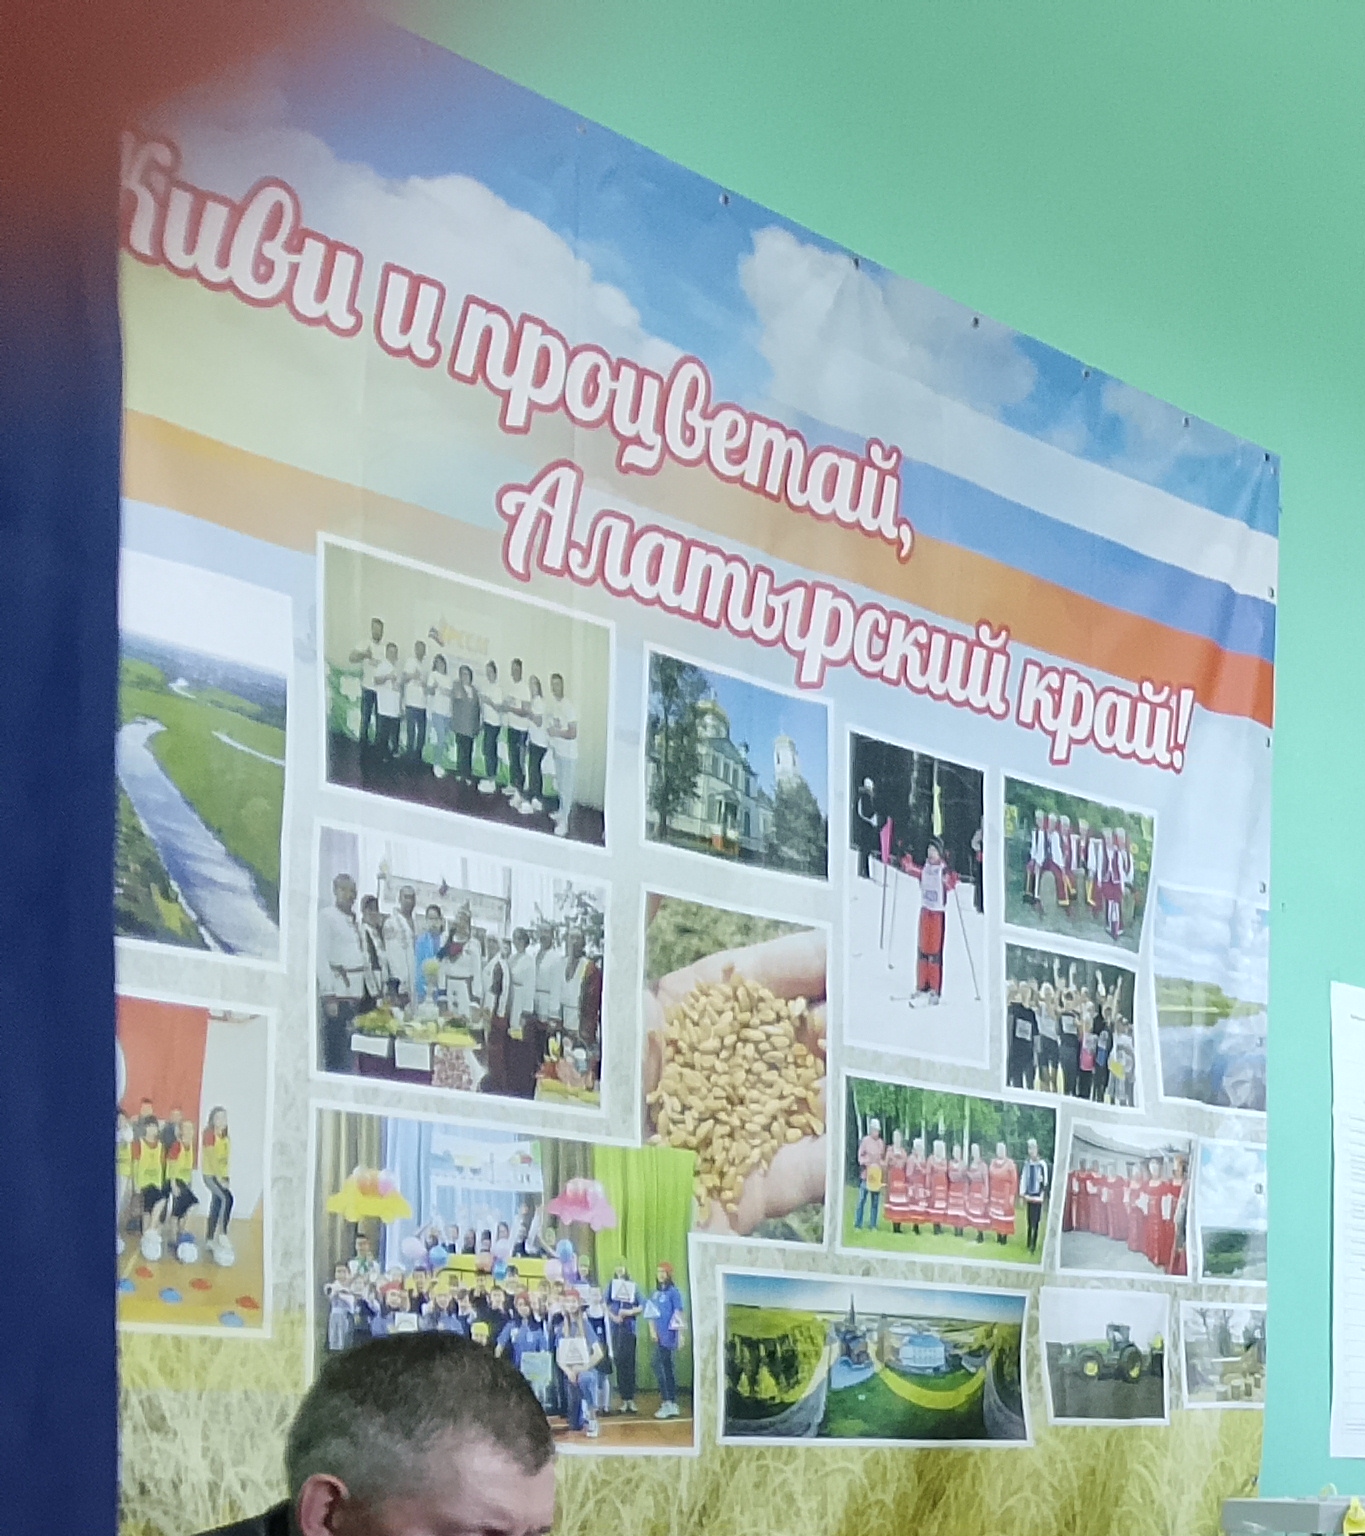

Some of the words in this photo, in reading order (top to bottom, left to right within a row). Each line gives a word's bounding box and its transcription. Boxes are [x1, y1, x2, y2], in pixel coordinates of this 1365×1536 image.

[373, 262, 442, 368] и
[451, 298, 916, 560] процветай,
[498, 461, 1011, 717] Алатырский
[1016, 650, 1196, 773] край!
